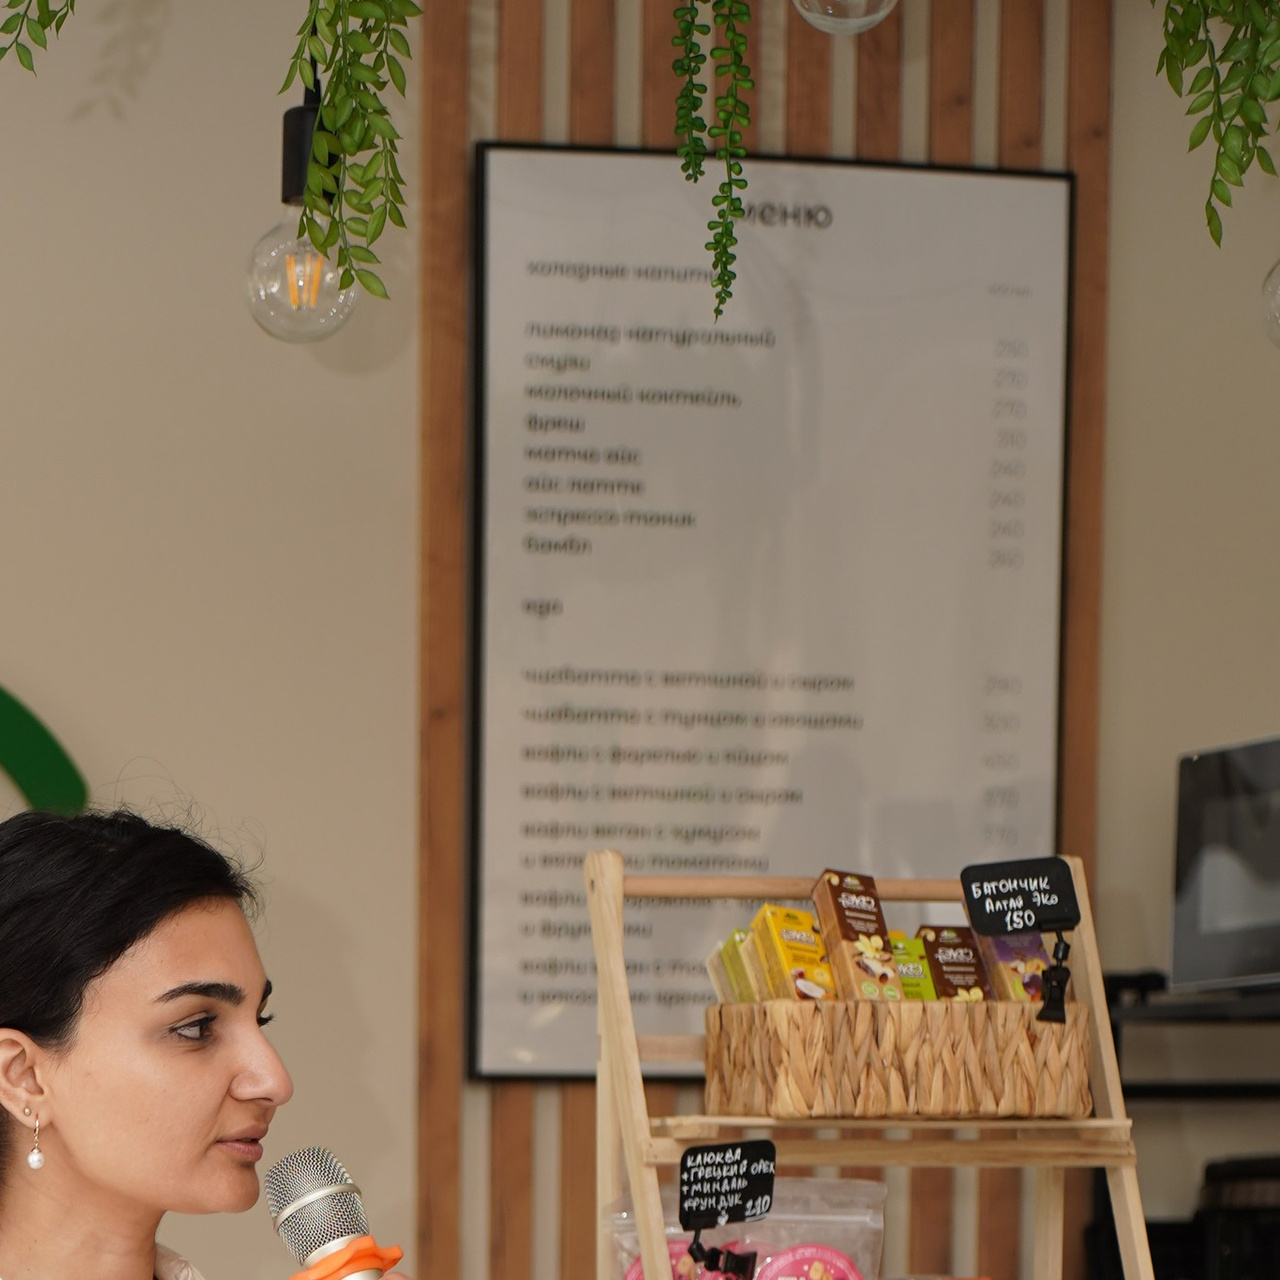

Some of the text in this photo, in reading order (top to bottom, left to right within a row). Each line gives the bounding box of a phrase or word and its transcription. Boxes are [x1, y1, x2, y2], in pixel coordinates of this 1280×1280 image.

[627, 327, 776, 348] натуральный
[524, 382, 742, 407] молочный коктейль
[971, 876, 1050, 899] БАТОНЧИК
[1005, 909, 1035, 931] 150
[687, 1147, 741, 1167] КЛЮКВА
[750, 1159, 775, 1175] ОРЕХ
